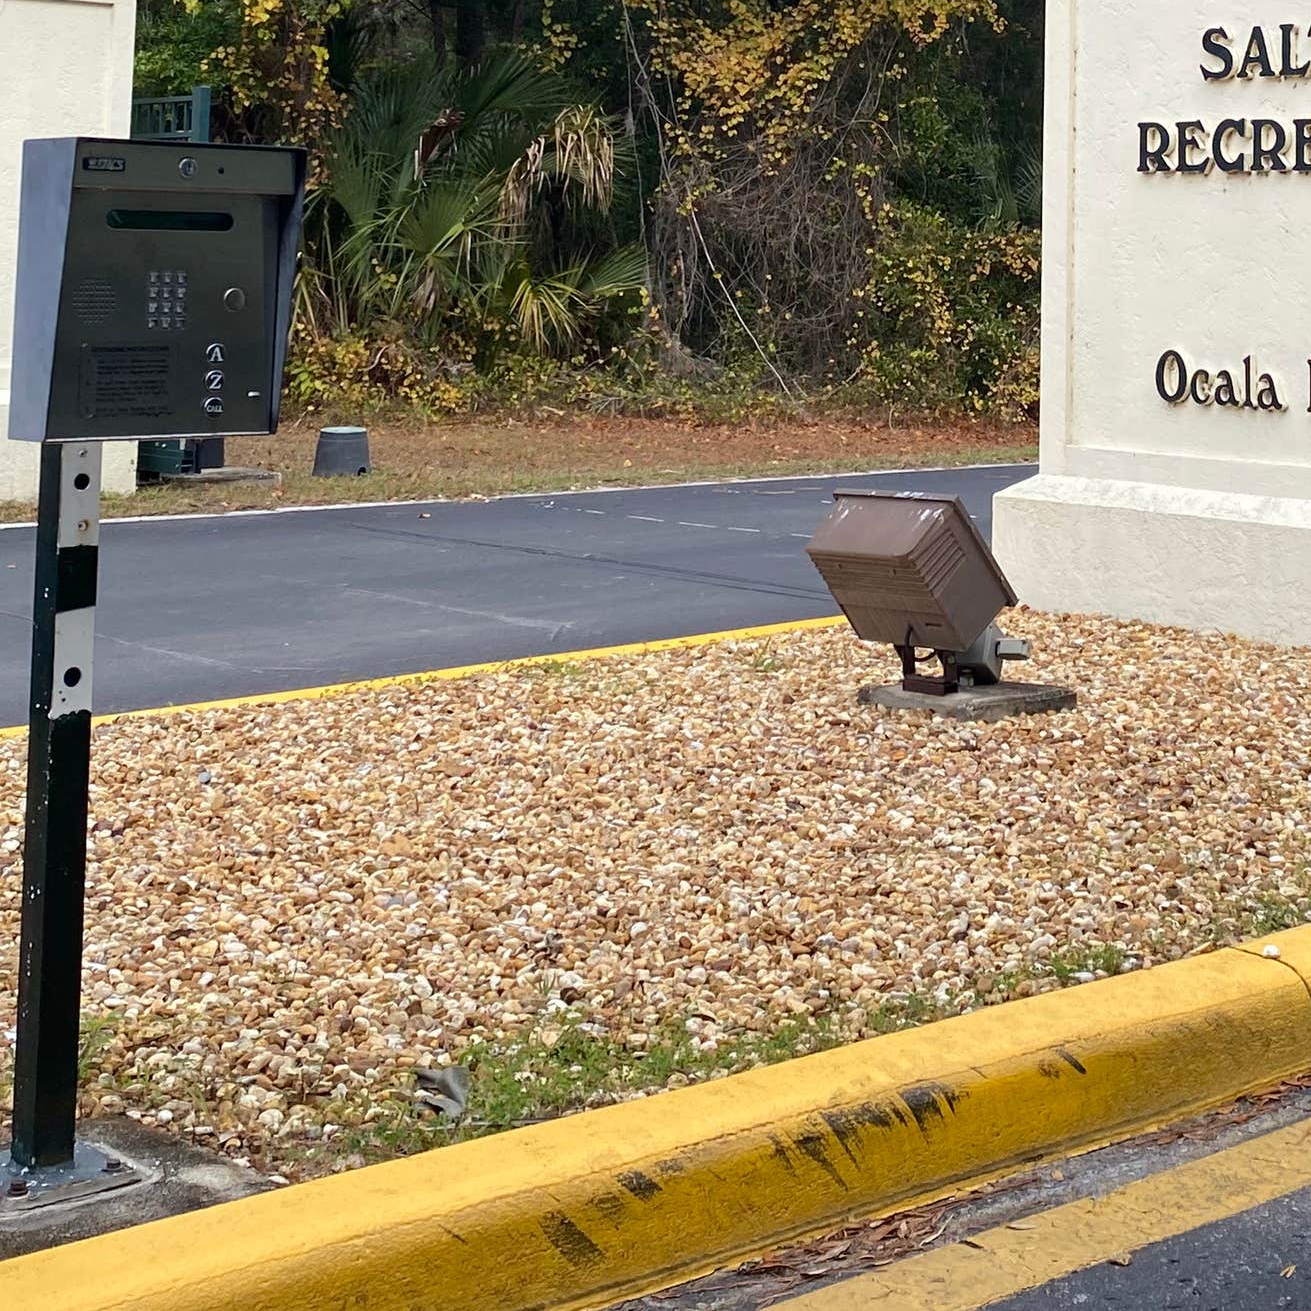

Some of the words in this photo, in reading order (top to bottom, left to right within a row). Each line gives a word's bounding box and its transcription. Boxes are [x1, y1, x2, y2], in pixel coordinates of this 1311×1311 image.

[209, 347, 224, 362] A
[208, 374, 222, 389] Z
[1156, 350, 1283, 410] Ocala
[206, 405, 223, 413] CALL
